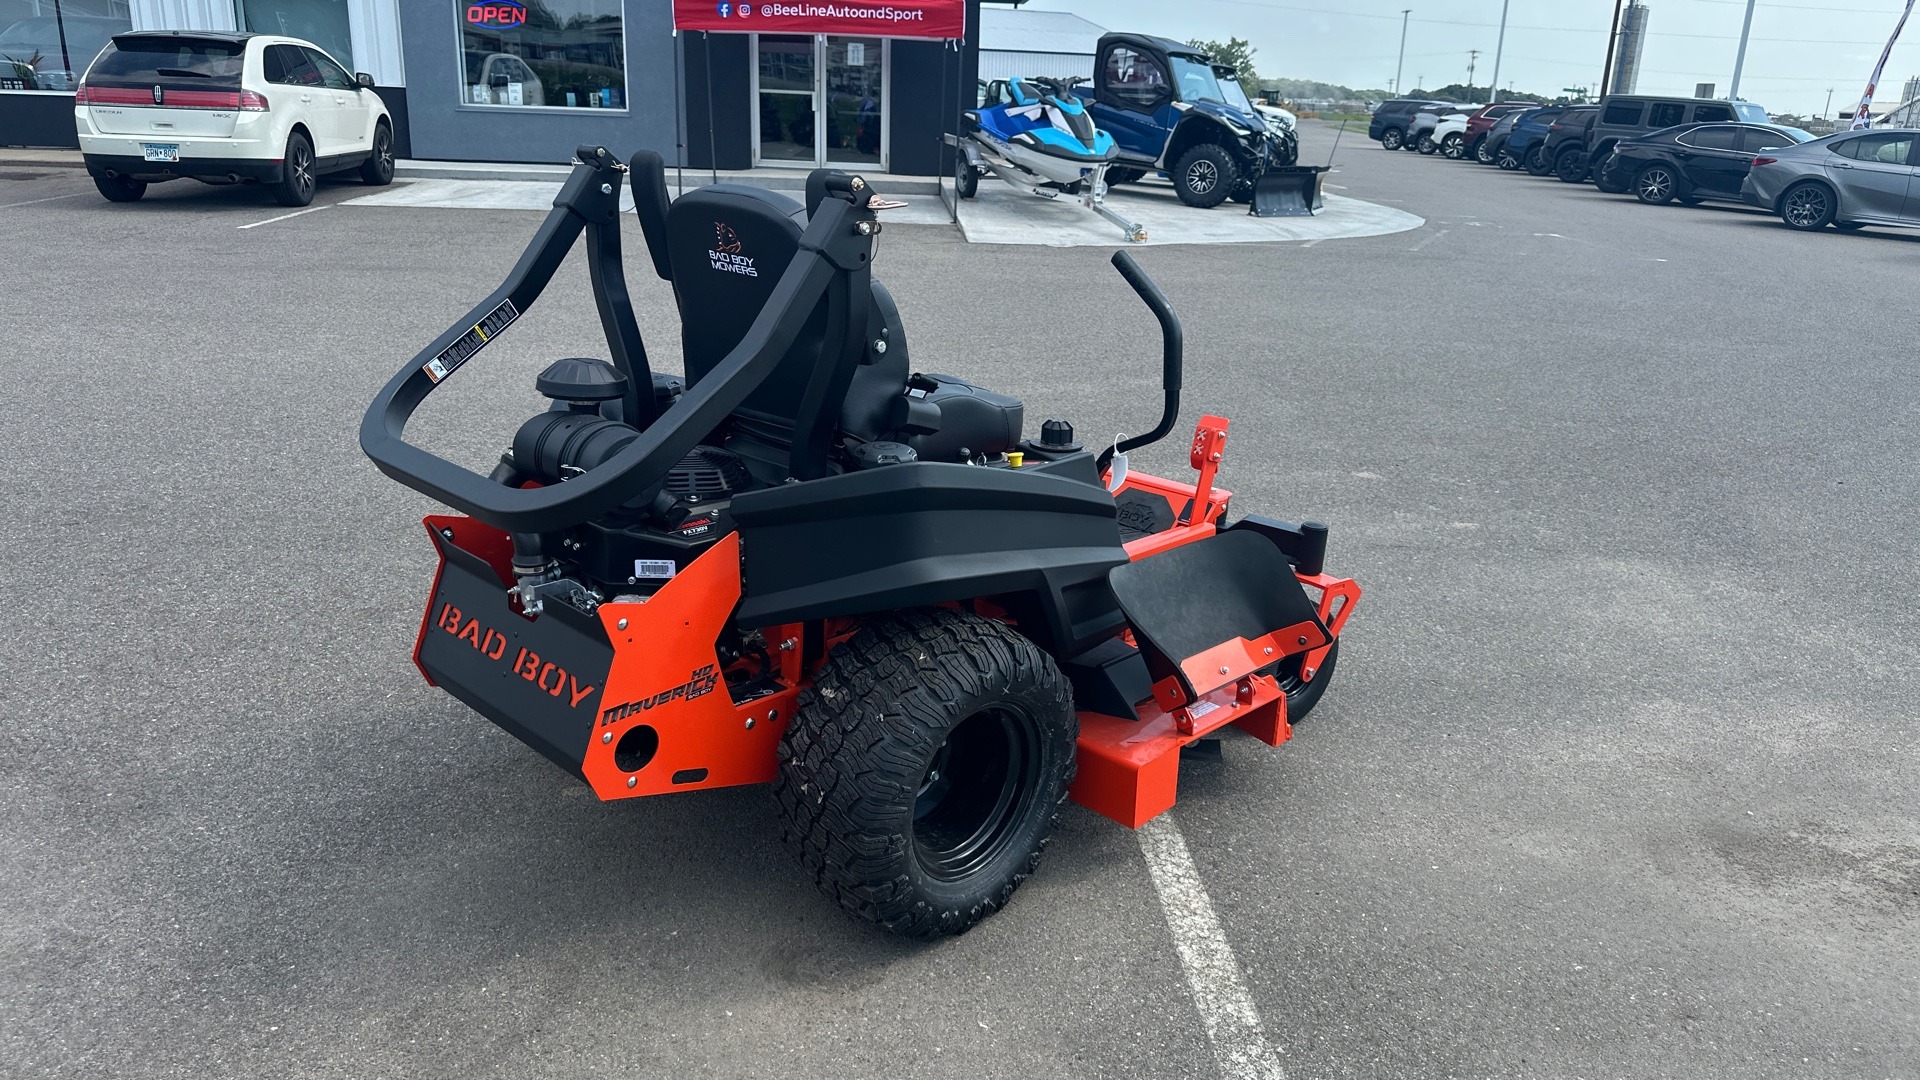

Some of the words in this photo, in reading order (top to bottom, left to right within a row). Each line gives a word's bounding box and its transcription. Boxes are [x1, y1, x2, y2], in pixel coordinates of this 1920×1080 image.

[467, 6, 527, 24] OPEN
[761, 4, 923, 21] @BeeLineAutoandSport
[708, 249, 730, 262] BAD
[731, 254, 754, 267] BOY
[711, 260, 758, 277] MOWERS
[437, 602, 507, 661] BAD
[512, 646, 596, 709] BOY
[691, 664, 715, 681] HD
[601, 672, 719, 727] MAVERICK
[688, 691, 700, 700] BAD
[700, 687, 712, 695] BOY
